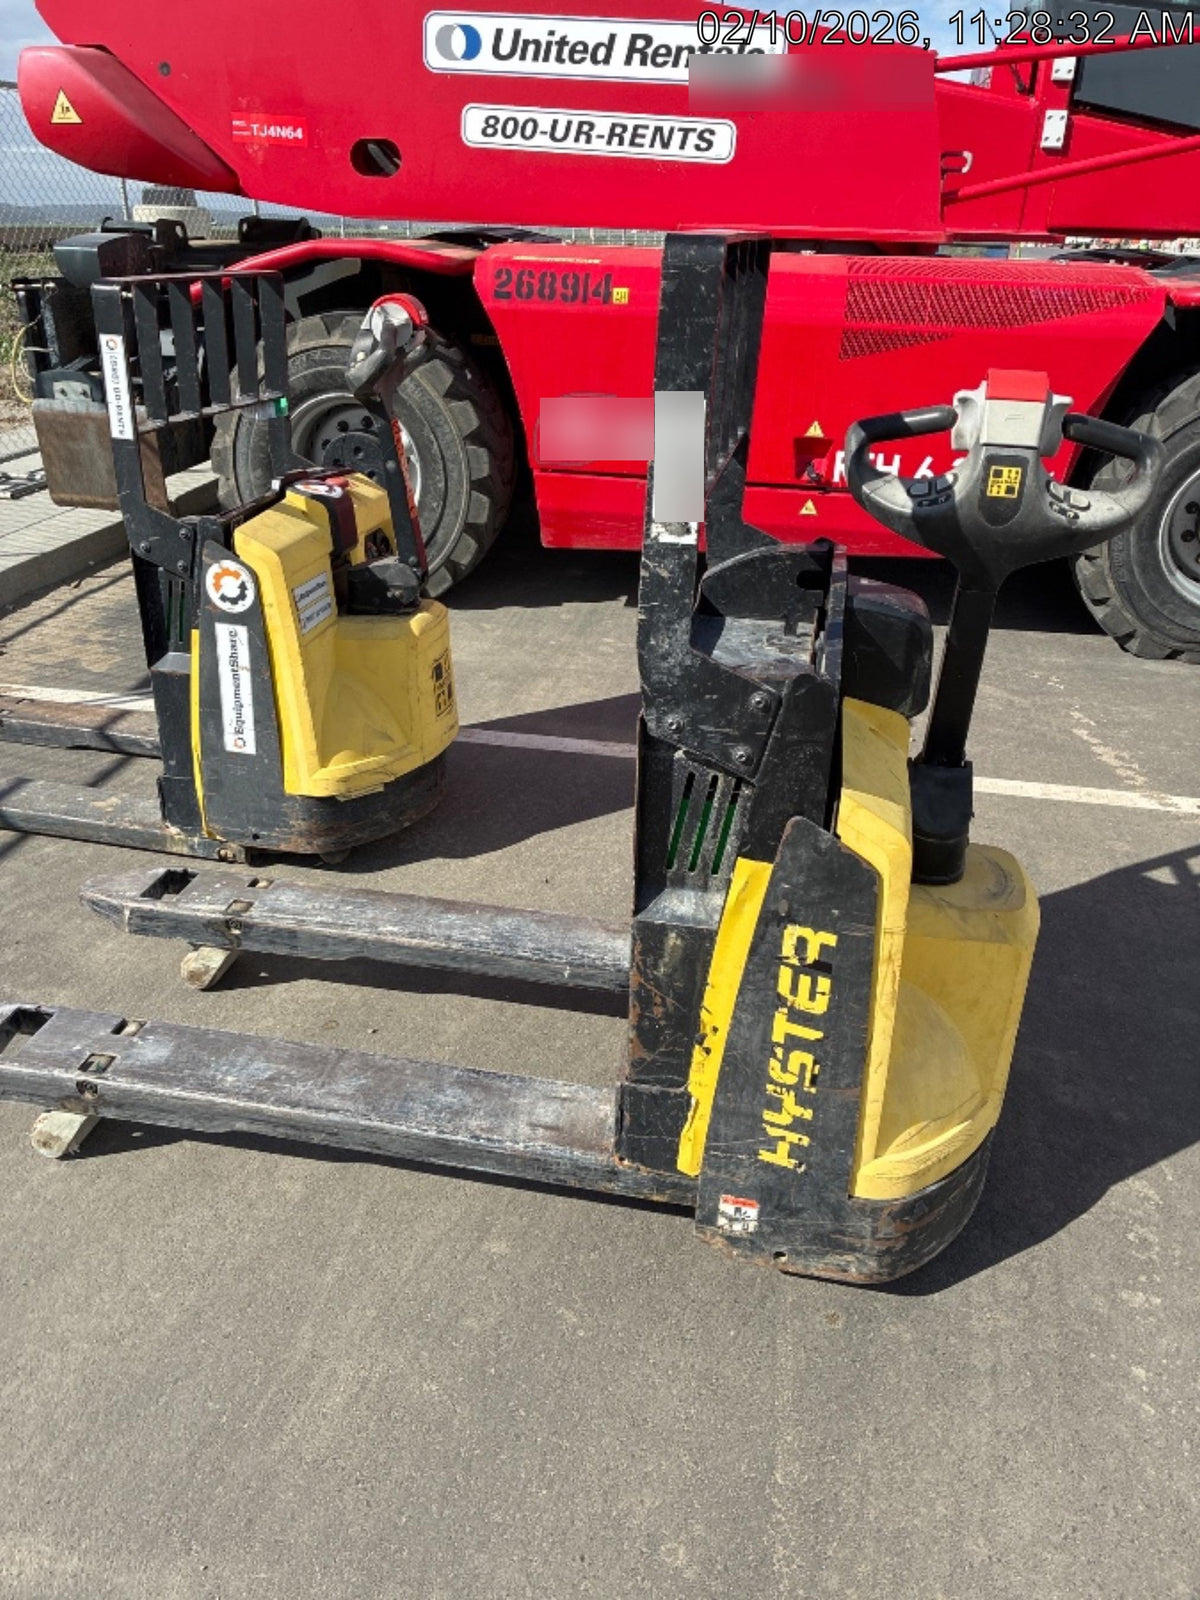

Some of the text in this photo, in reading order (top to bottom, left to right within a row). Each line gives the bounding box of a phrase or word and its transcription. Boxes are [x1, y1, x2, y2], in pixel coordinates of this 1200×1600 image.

[491, 28, 617, 66] United
[250, 124, 303, 140] TJ4N64
[481, 115, 716, 152] 800-UR-RENTS
[494, 268, 612, 304] 268914
[832, 451, 901, 482] RH
[757, 923, 838, 1172] HYSTER
